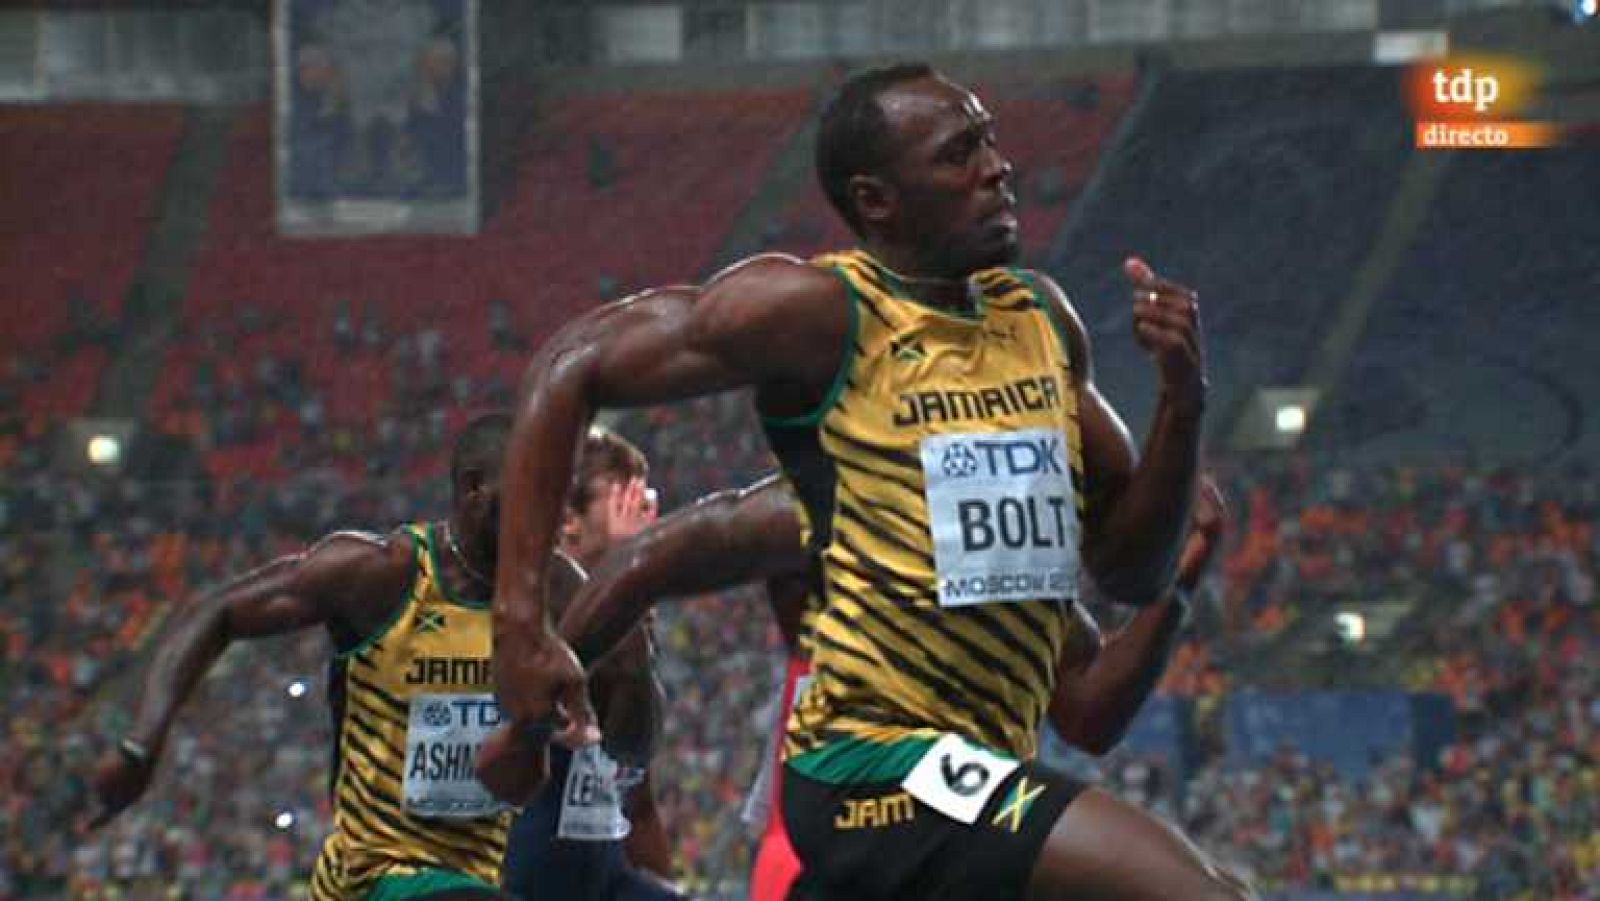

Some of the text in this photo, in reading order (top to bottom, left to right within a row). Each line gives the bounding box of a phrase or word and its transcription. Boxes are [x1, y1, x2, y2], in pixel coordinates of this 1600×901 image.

[892, 377, 1060, 427] JAMAICA
[973, 437, 1063, 476] TDK
[957, 495, 1066, 551] BOLT
[451, 700, 500, 726] TD
[940, 753, 989, 797] 6
